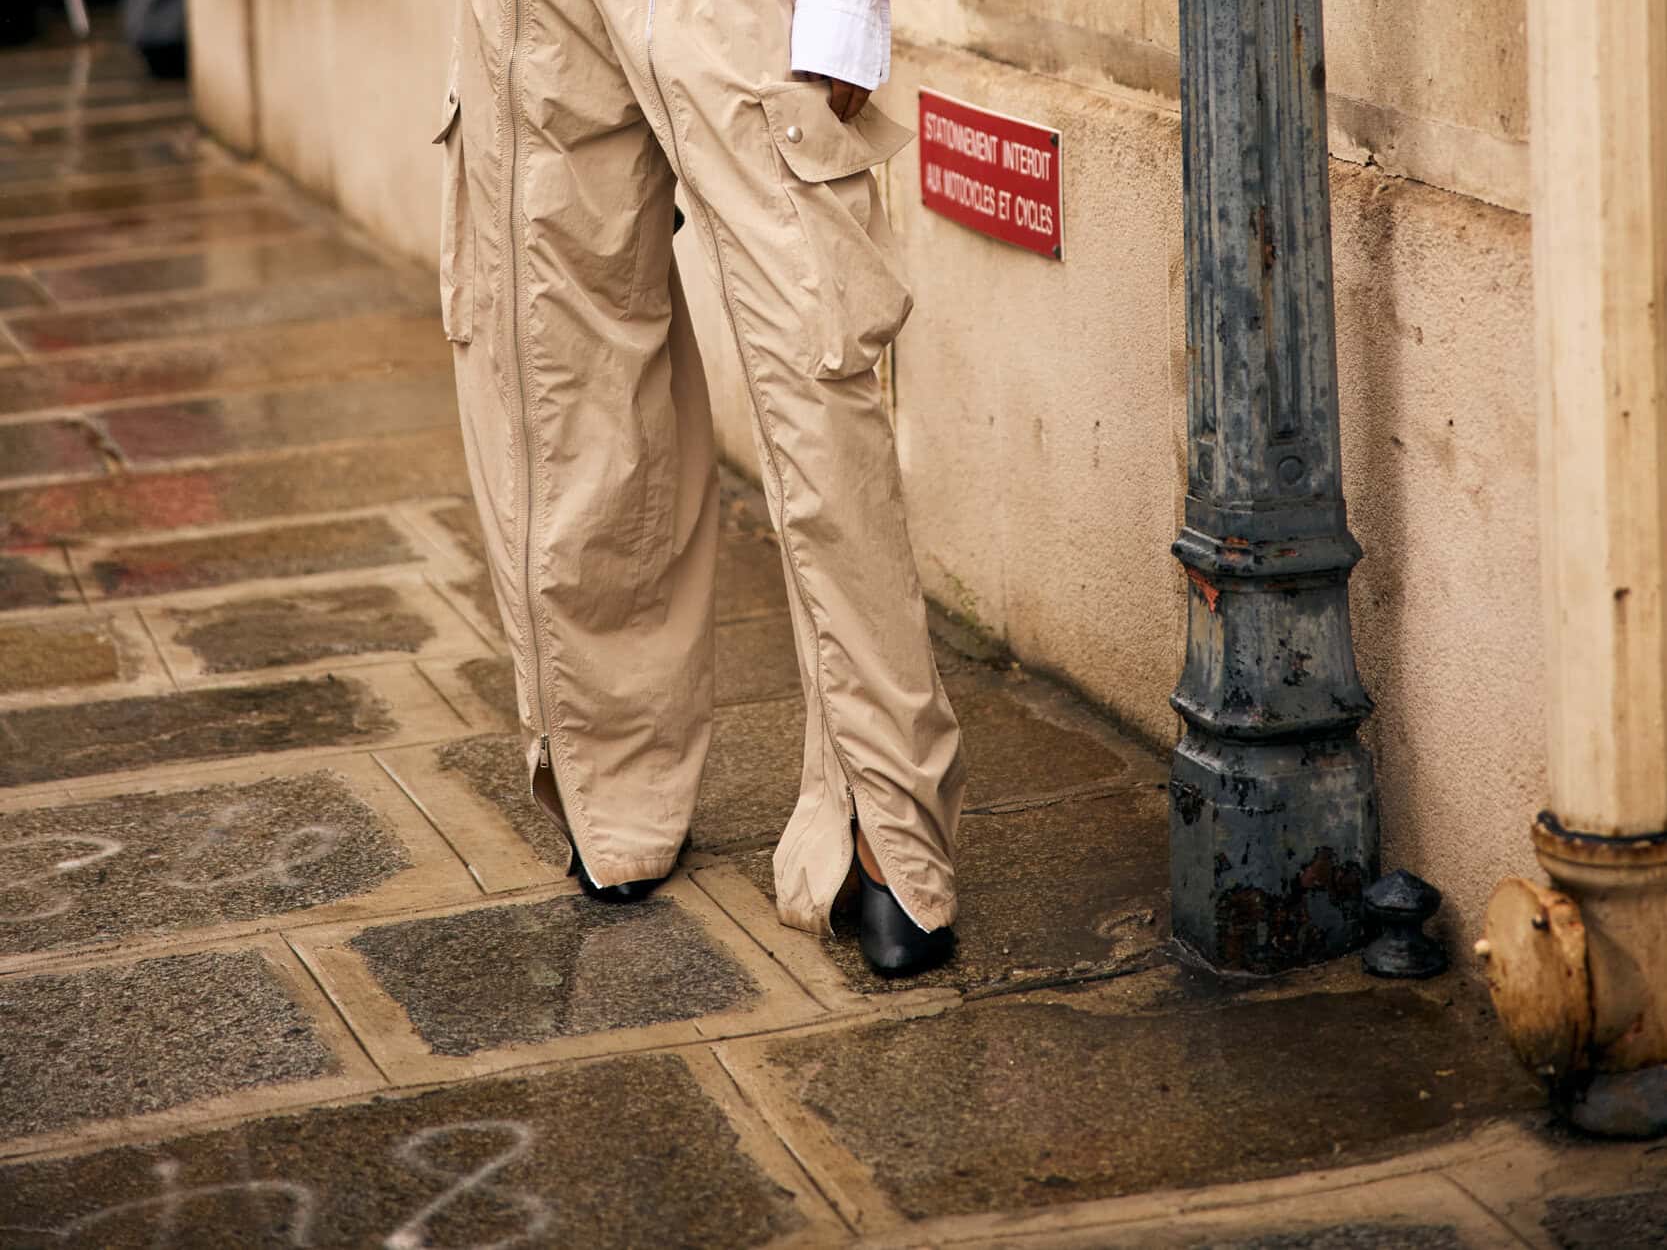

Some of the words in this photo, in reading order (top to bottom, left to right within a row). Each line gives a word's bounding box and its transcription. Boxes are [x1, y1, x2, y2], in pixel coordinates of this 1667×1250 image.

[924, 111, 998, 165] STATIONNEMENT
[1002, 139, 1052, 181] INTERDIT
[926, 162, 943, 193] AUX
[943, 169, 996, 217] MOTOCYCLES
[999, 189, 1012, 221] ET
[1014, 195, 1053, 236] CYCLES
